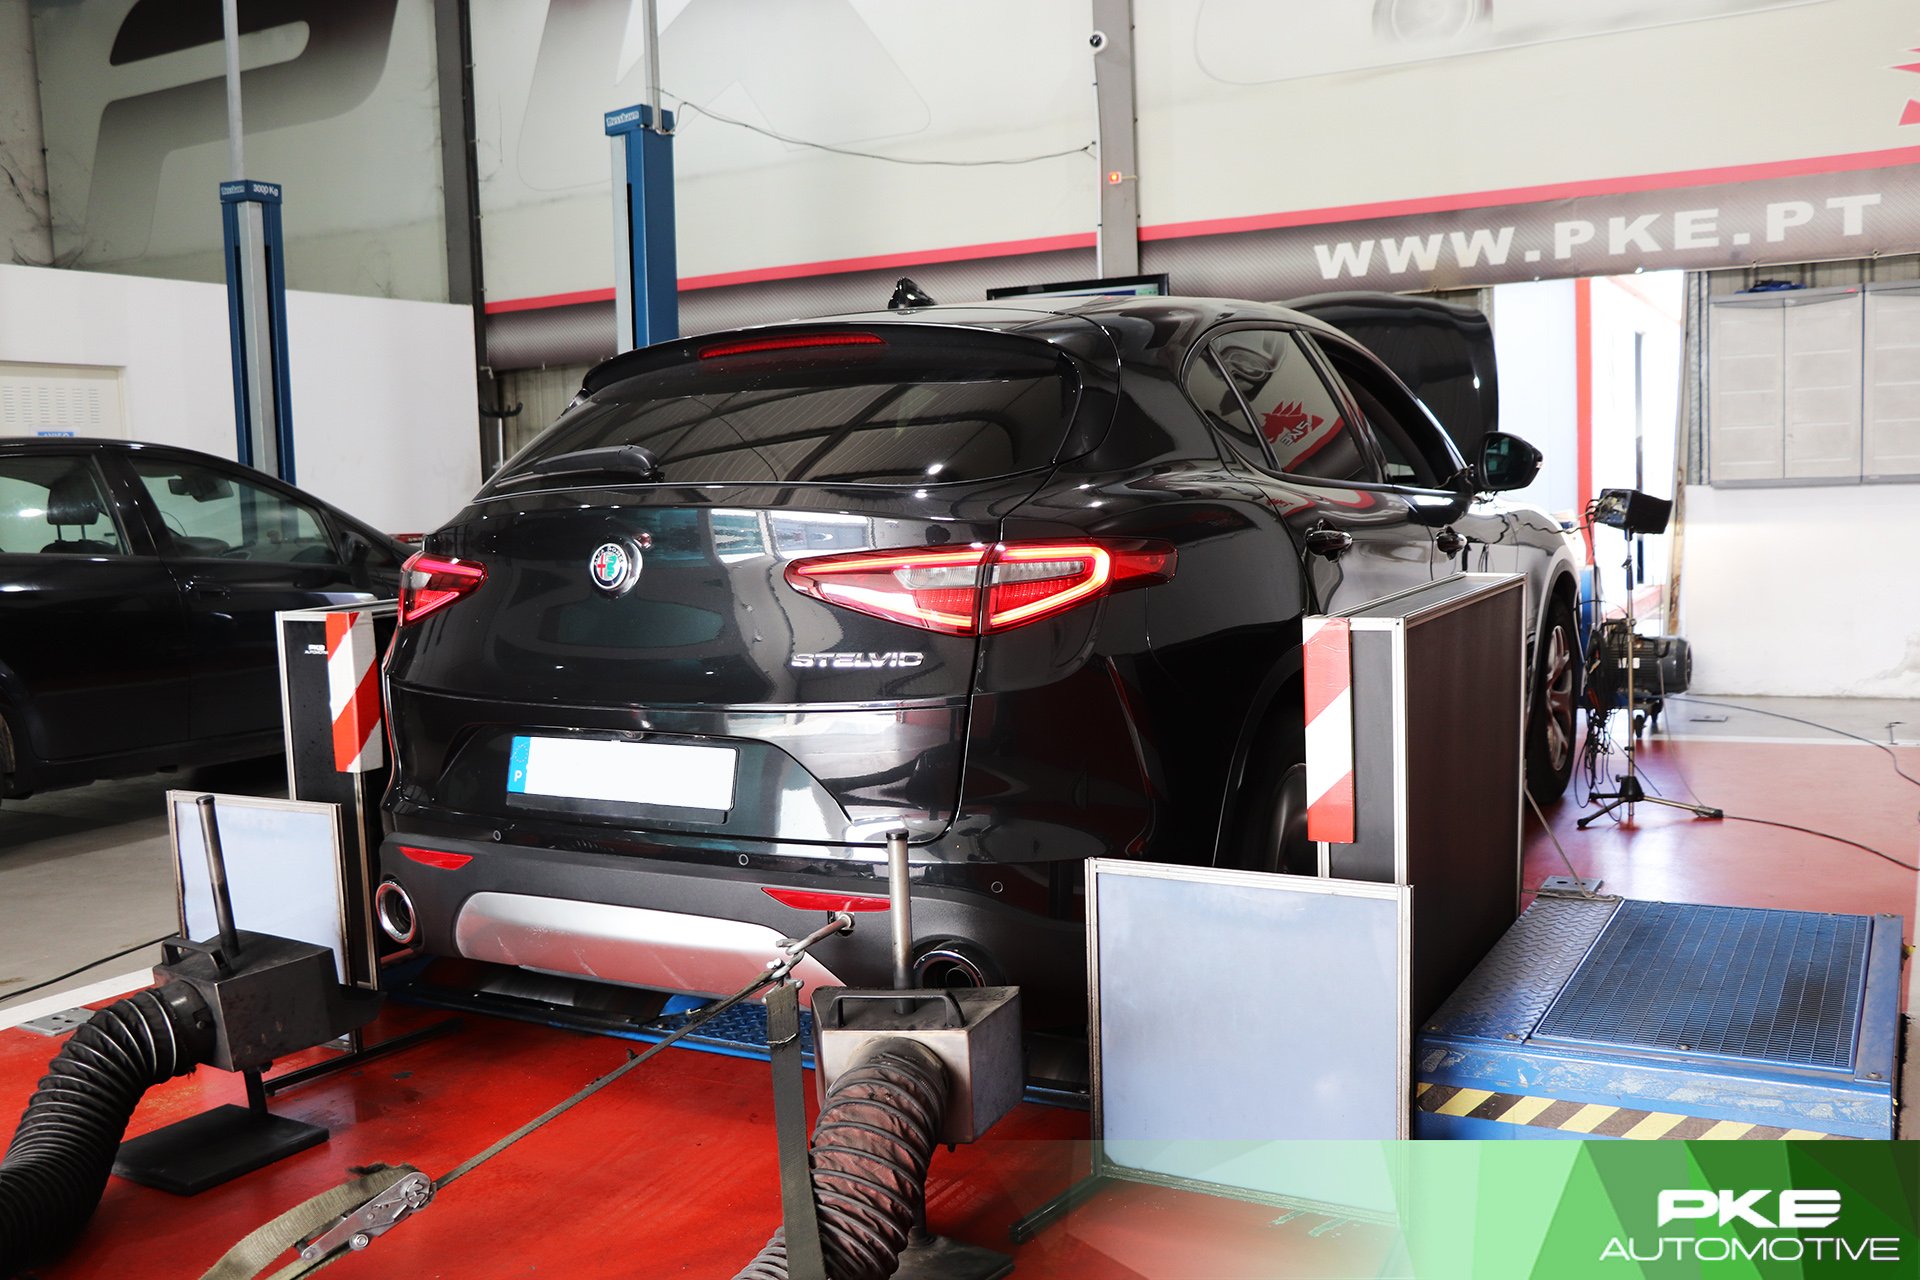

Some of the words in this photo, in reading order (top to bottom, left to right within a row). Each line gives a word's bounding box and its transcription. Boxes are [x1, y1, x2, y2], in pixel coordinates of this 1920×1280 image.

[1313, 193, 1882, 281] WWW.PKE.PT
[790, 651, 924, 668] STELVIO
[514, 769, 524, 783] P
